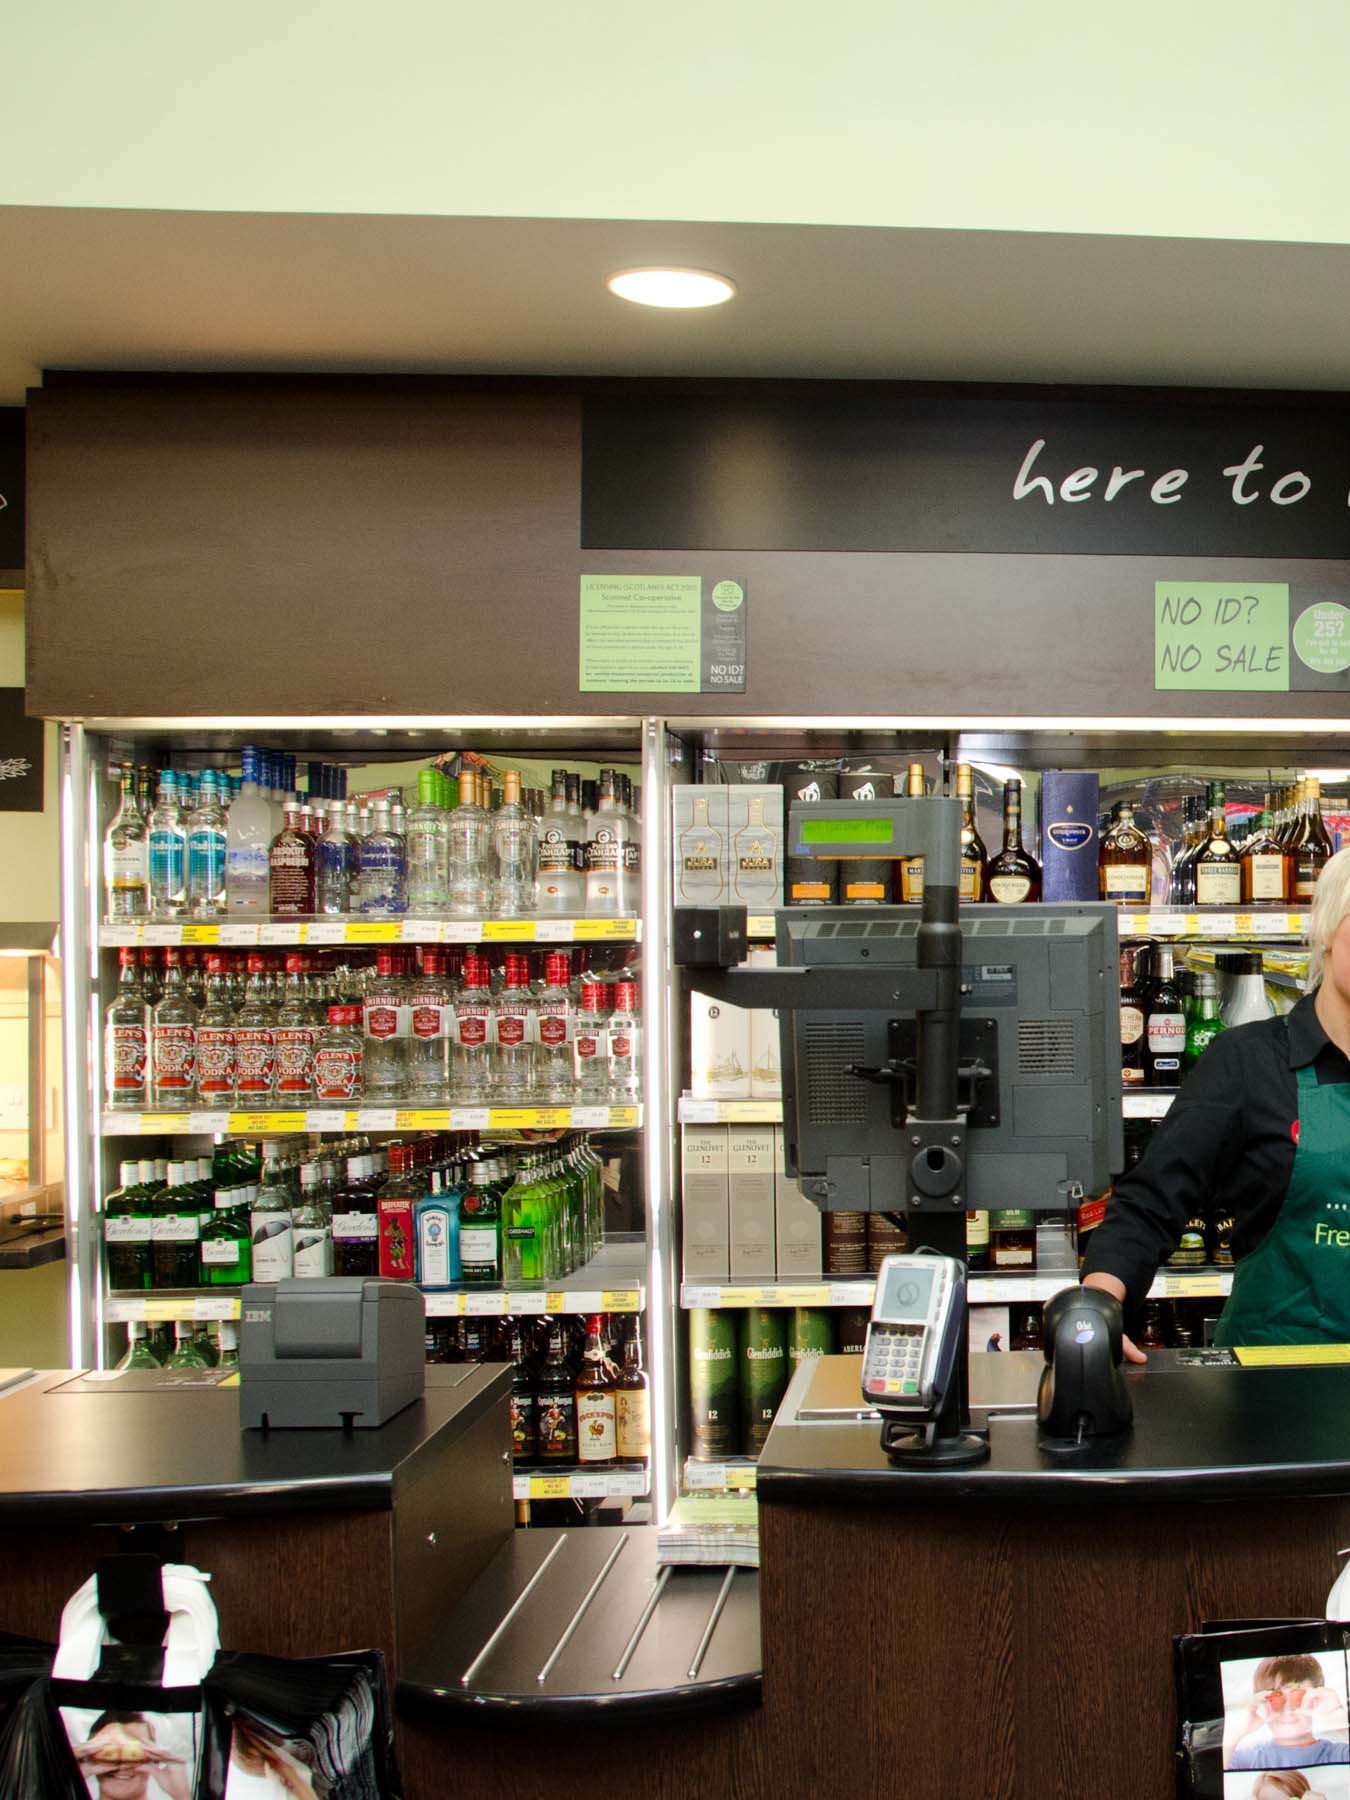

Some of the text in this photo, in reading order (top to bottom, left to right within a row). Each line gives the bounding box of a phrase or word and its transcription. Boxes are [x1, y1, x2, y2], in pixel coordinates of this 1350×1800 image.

[1011, 439, 1189, 505] here
[1222, 444, 1311, 505] to
[1161, 595, 1260, 625] NO ID?
[1312, 621, 1346, 638] 25?
[1161, 644, 1284, 673] NO SALE
[710, 664, 727, 676] NO
[728, 664, 744, 676] ID?
[710, 676, 744, 684] NO SALE
[686, 858, 715, 867] JURA
[741, 858, 769, 867] JURA
[112, 1028, 142, 1038] LEN'S
[155, 1028, 191, 1038] GLEN'S
[199, 1032, 233, 1042] GLEN'S
[276, 1031, 311, 1041] GLEN'S
[319, 1052, 350, 1061] GLEN'S
[113, 1063, 141, 1073] ODKA
[156, 1063, 190, 1073] VODKA
[199, 1067, 233, 1077] VODKA
[237, 1066, 270, 1076] VODKA
[277, 1066, 310, 1076] VODKA
[320, 1078, 349, 1087] VODKA
[700, 1154, 712, 1164] 12
[746, 1154, 757, 1163] 12
[245, 1310, 272, 1322] IBM
[747, 1346, 783, 1360] Glenfiddich
[707, 1409, 719, 1420] 12
[762, 1408, 773, 1419] 12
